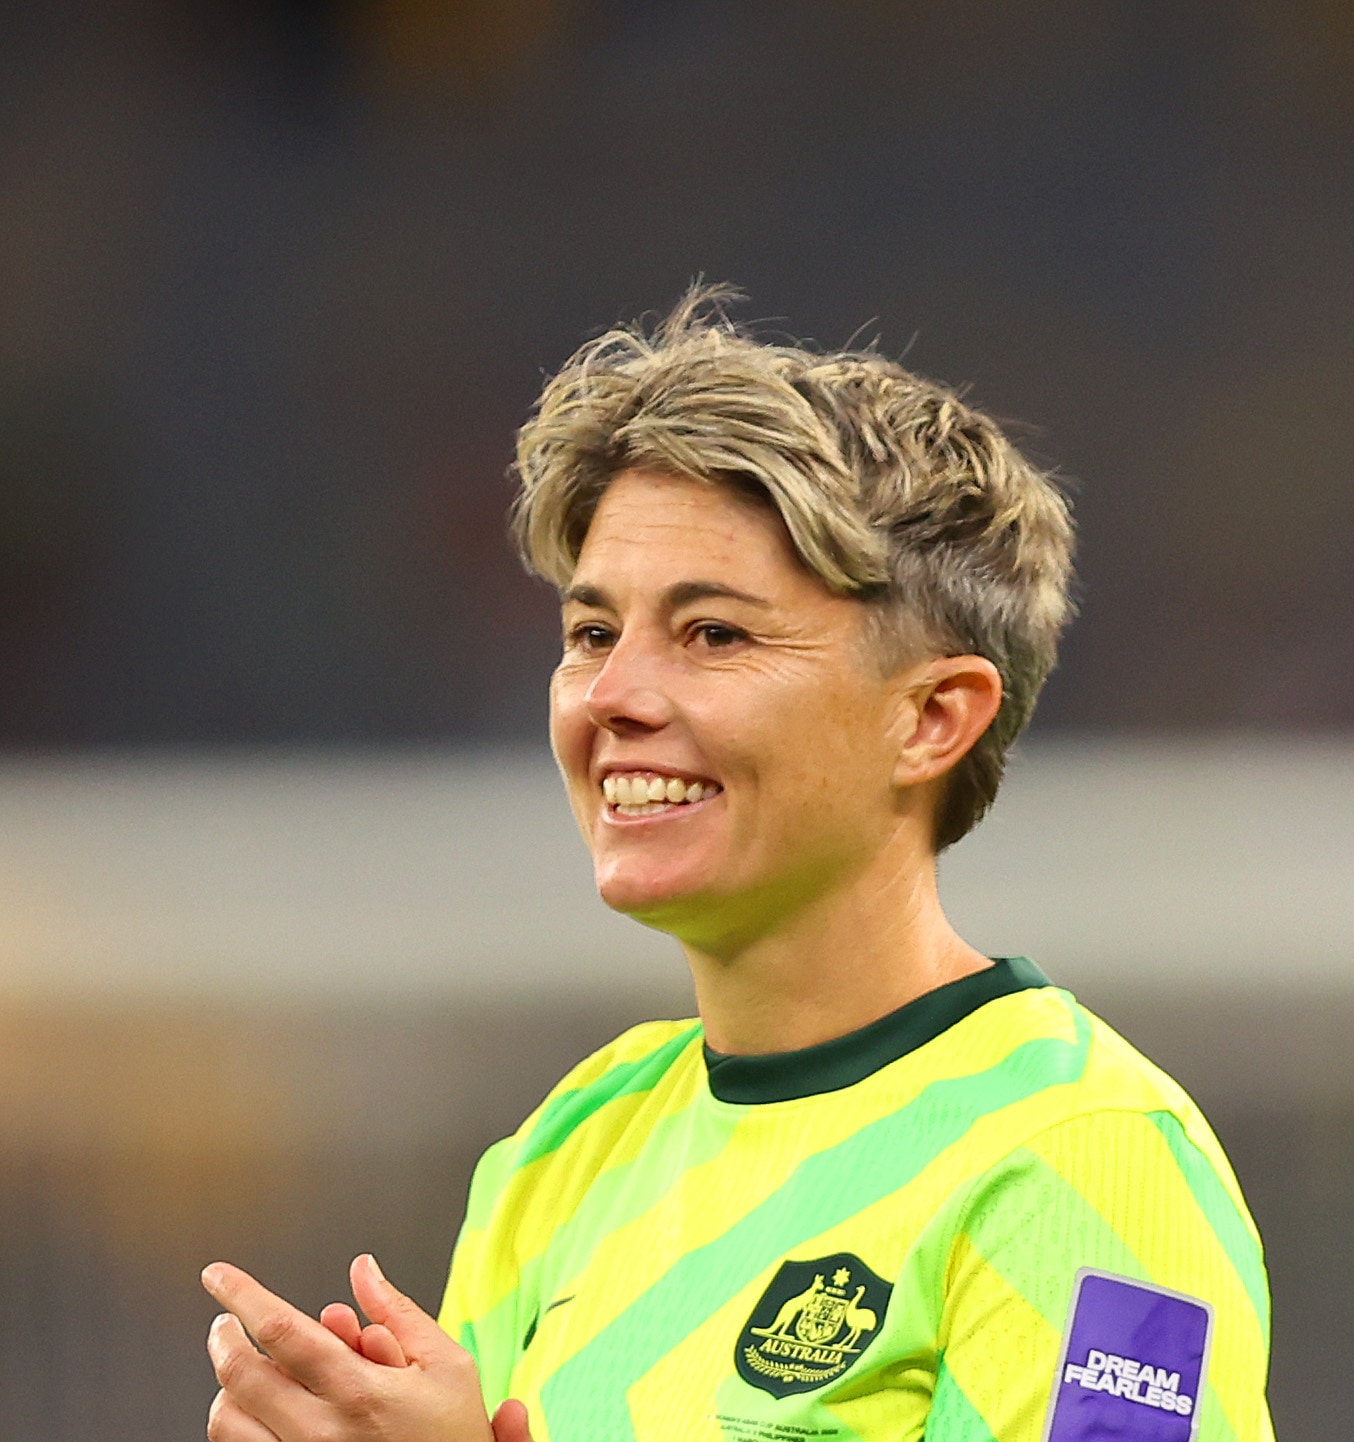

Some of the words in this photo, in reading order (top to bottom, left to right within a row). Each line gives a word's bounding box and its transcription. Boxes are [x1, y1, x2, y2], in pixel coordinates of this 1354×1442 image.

[759, 1338, 843, 1365] AUSTRALIA
[1087, 1349, 1181, 1392] DREAM
[1064, 1363, 1193, 1416] FEARLESS
